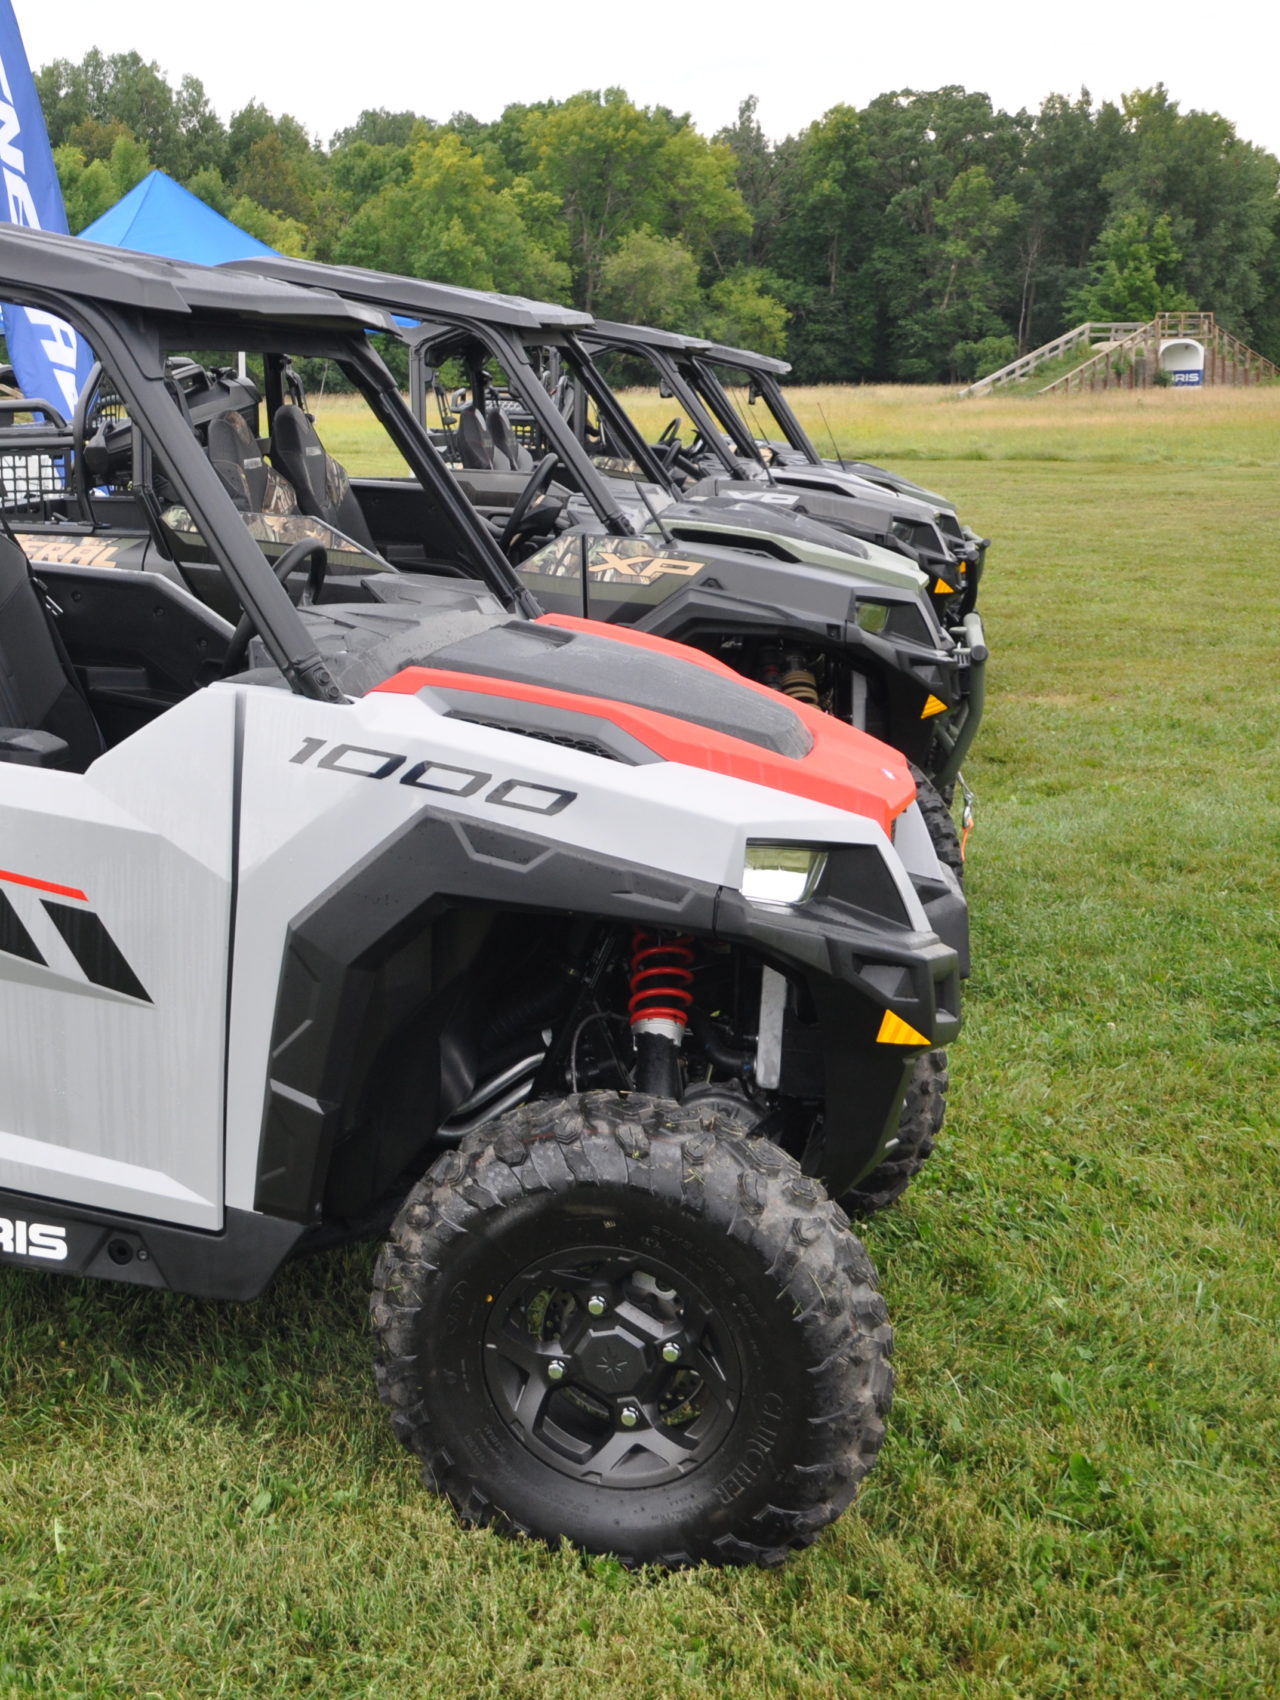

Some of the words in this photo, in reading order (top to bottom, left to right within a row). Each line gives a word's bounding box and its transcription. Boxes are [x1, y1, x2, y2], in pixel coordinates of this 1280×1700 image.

[23, 540, 120, 568] ERAL
[588, 552, 705, 576] XP
[288, 736, 578, 816] 1000
